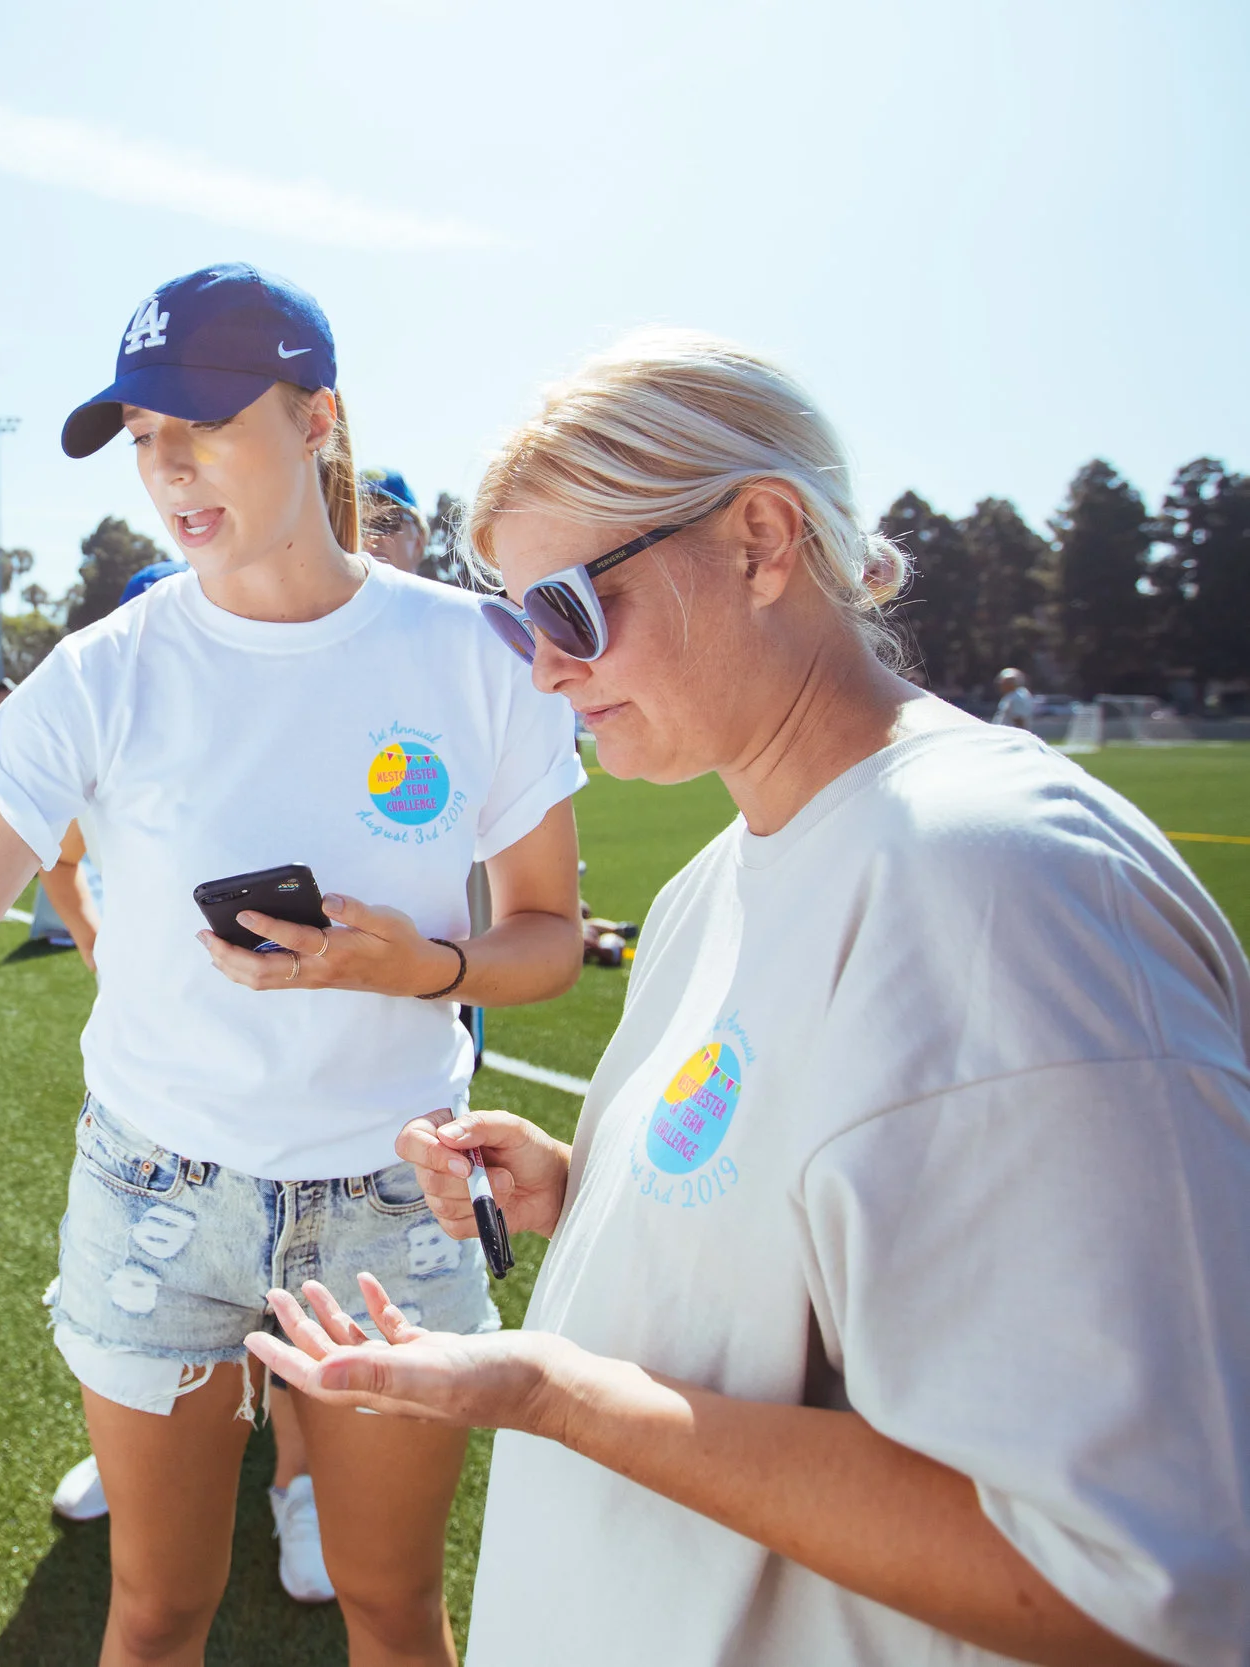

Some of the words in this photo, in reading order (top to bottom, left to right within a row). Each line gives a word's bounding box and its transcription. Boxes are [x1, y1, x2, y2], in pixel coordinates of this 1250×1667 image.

[125, 293, 170, 355] LA
[596, 549, 627, 569] PERVERSE
[390, 720, 442, 744] Annual
[376, 768, 438, 783] WESTCHESTER
[390, 785, 402, 797] CA
[406, 784, 430, 796] TEAM
[355, 810, 408, 843] August
[415, 827, 439, 844] 3rd
[441, 790, 468, 832] 2019
[386, 798, 437, 812] CHALLENGE
[680, 1105, 706, 1135] TEAM
[653, 1116, 700, 1163] CHALLENGE
[640, 1171, 674, 1205] 3rd
[682, 1155, 739, 1208] 2019
